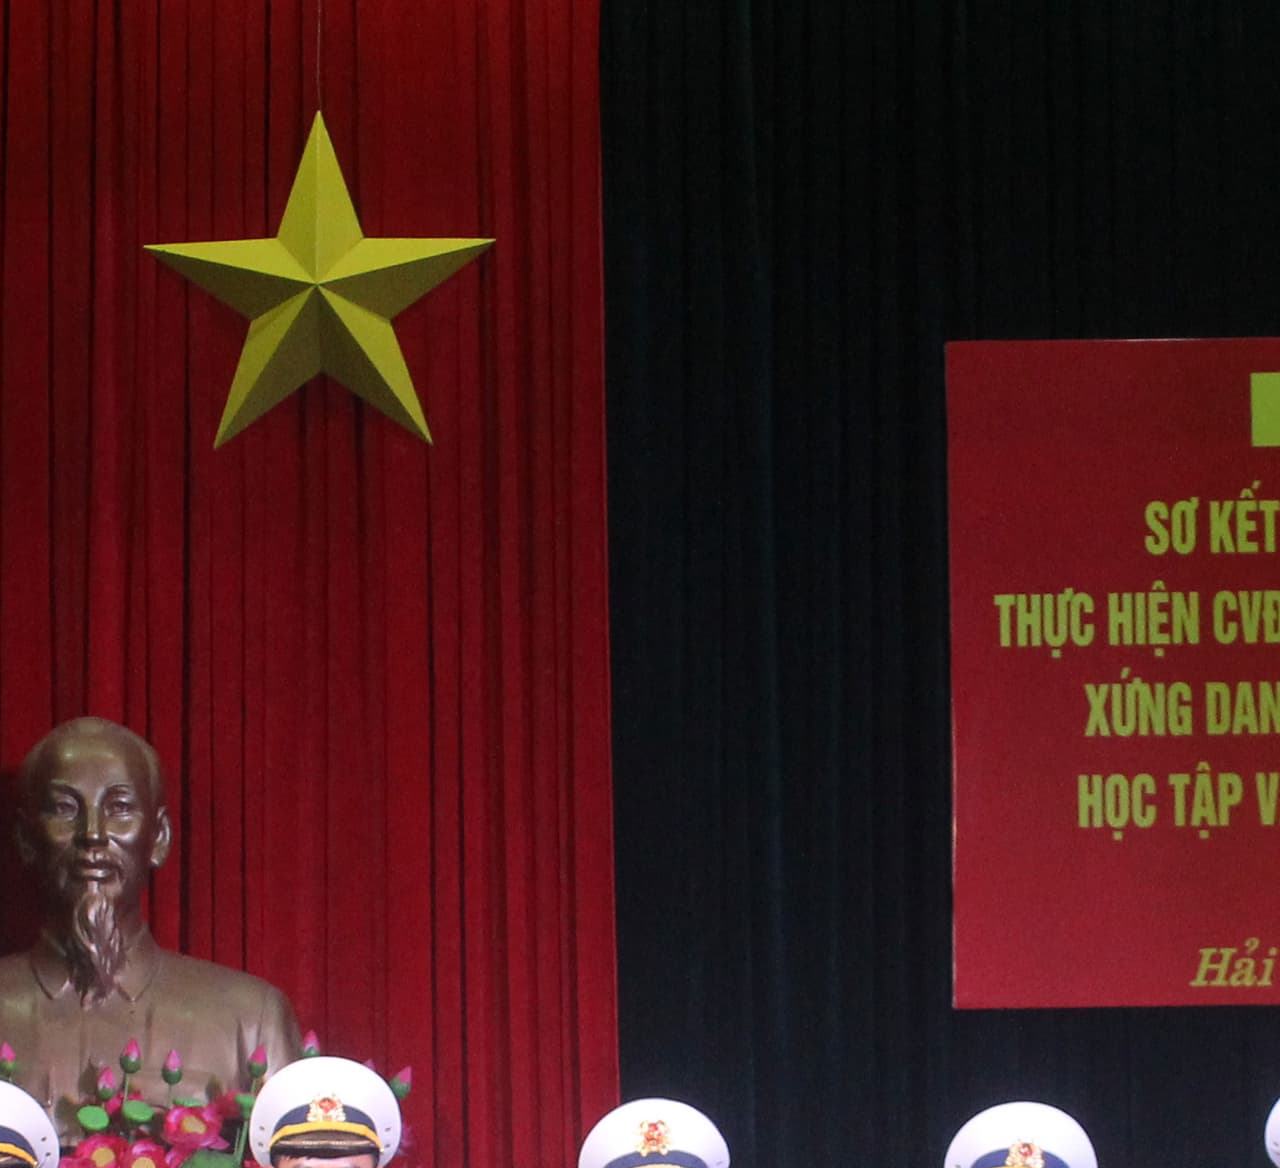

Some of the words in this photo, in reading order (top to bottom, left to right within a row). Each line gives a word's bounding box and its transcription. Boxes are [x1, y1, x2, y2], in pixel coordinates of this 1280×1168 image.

[1145, 497, 1199, 555] SƠ
[1210, 481, 1280, 553] KẾT
[994, 588, 1095, 658] THỰC
[1108, 580, 1200, 656] HIỆN
[1085, 667, 1192, 736] XỨNG
[1078, 774, 1156, 840] HỌC
[1168, 762, 1243, 839] TẬP
[1191, 938, 1277, 986] Hải
